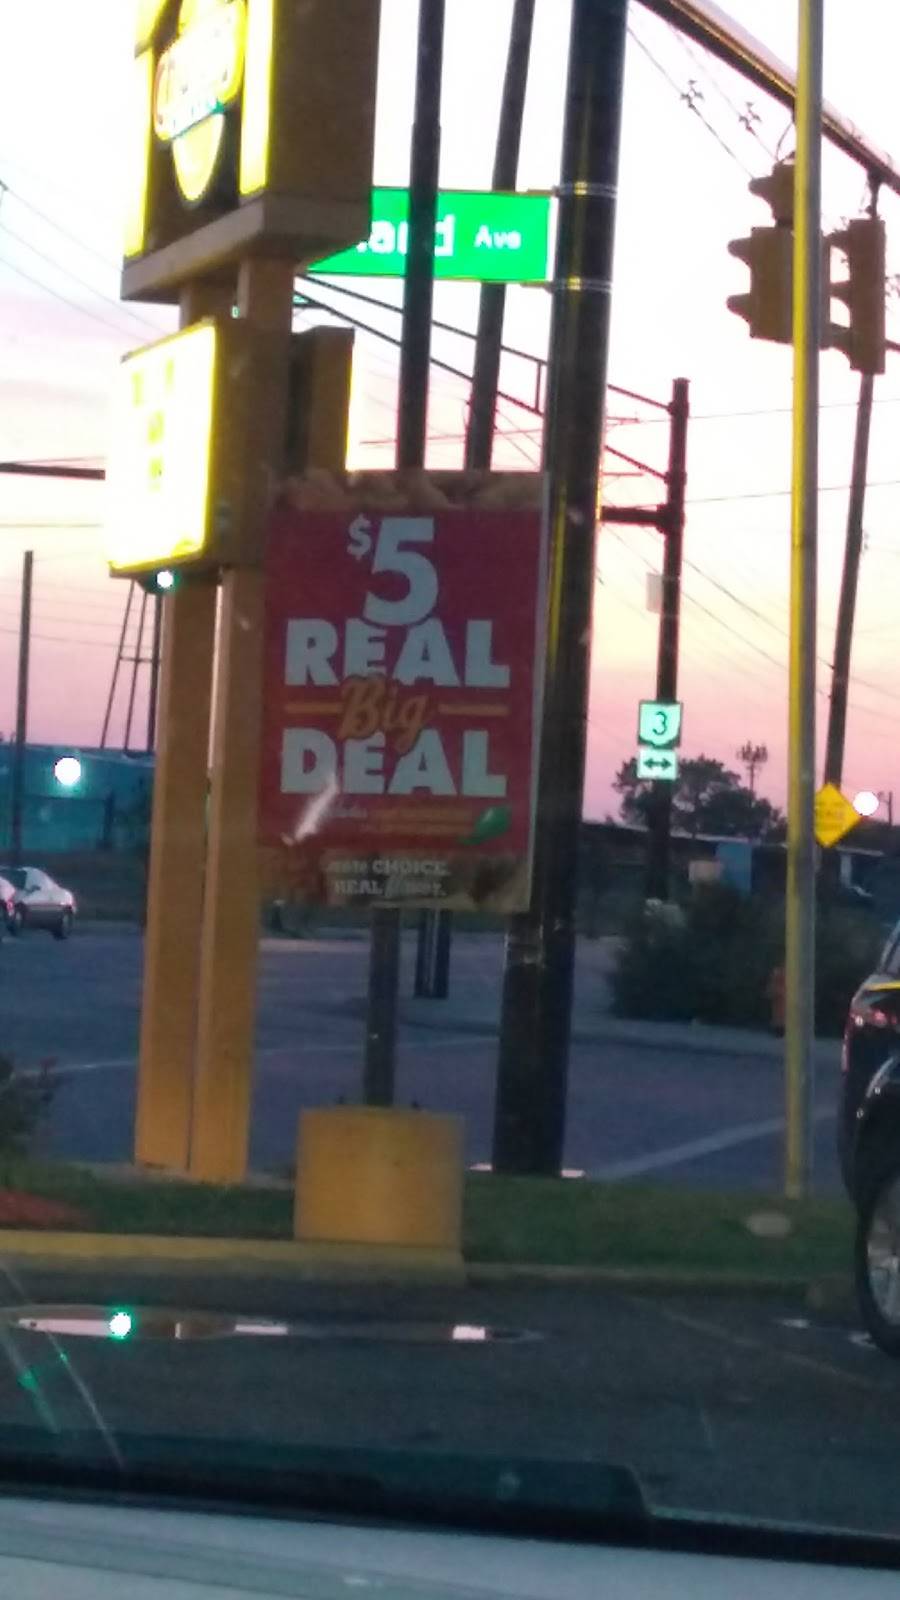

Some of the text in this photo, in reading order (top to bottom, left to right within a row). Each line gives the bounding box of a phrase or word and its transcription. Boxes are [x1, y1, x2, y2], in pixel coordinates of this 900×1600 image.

[474, 225, 522, 249] Ave
[347, 514, 438, 626] $5
[284, 617, 510, 688] REAL
[336, 677, 430, 754] Big
[652, 711, 668, 736] 3
[280, 728, 507, 798] DEAL
